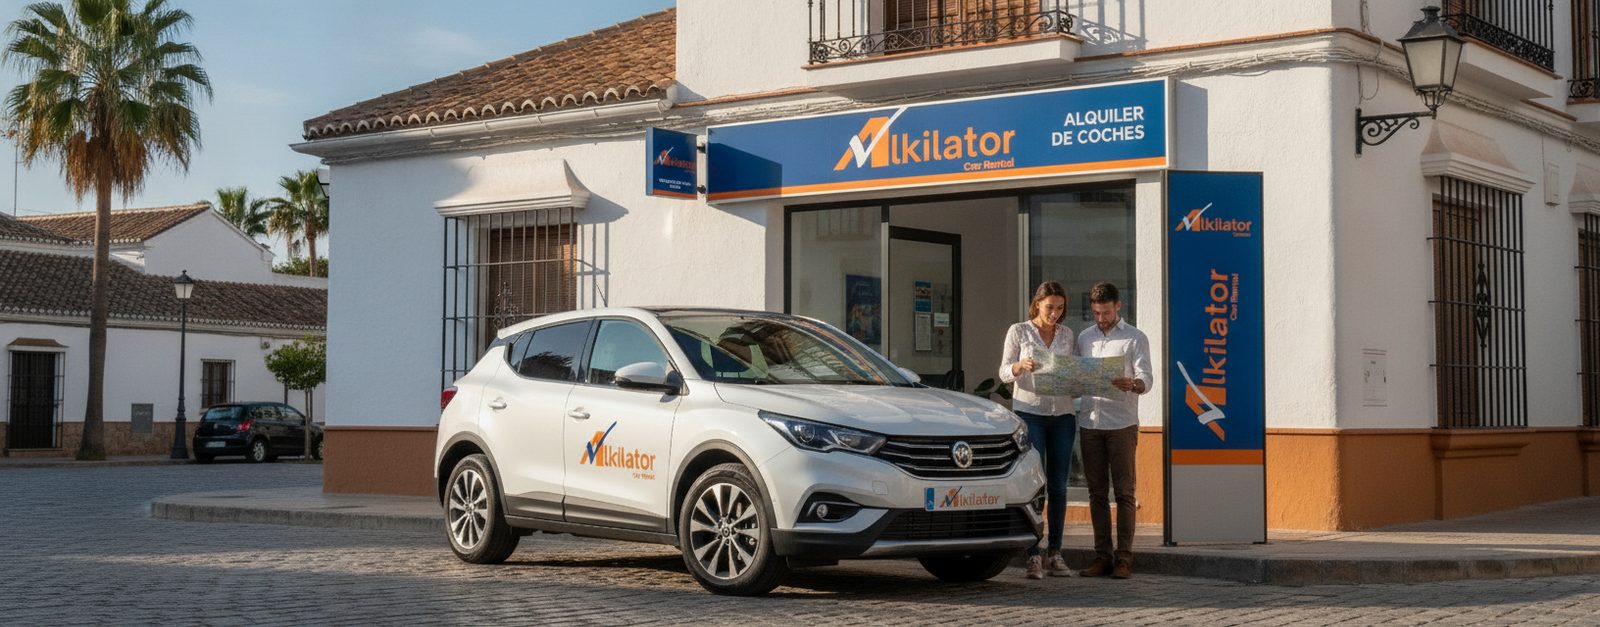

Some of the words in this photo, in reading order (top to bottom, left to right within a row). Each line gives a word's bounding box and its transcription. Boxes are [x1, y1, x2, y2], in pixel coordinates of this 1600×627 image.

[1063, 105, 1145, 127] ALQUILER
[833, 115, 1016, 171] Alkilator
[1051, 130, 1073, 147] DE
[1077, 124, 1145, 145] COCHES
[1175, 207, 1252, 232] Alkilator
[1184, 268, 1229, 442] Alkilator
[579, 430, 656, 471] Alkilator
